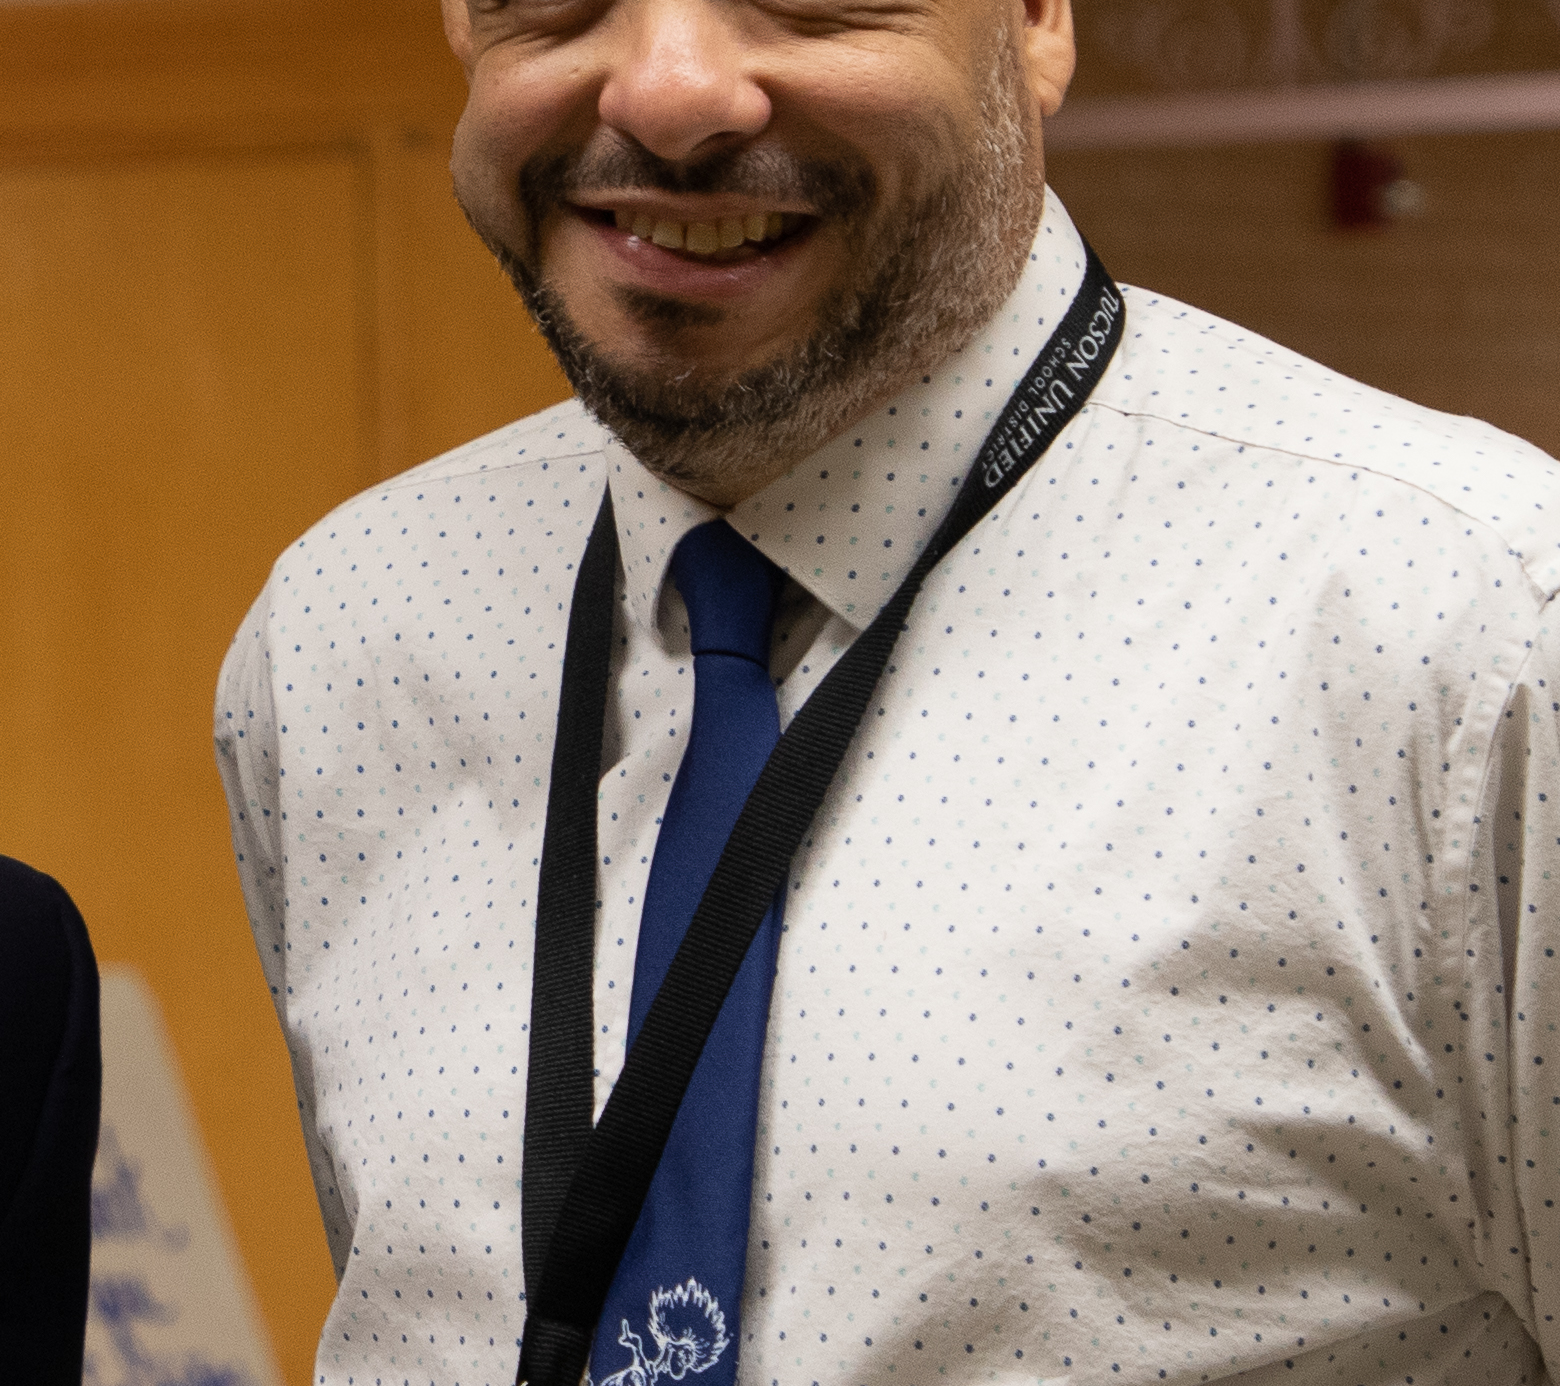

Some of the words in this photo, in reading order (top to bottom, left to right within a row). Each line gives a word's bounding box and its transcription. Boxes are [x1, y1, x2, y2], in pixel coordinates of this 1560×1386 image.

[1027, 337, 1072, 396] SCHOOL
[1065, 286, 1121, 381] TUCSON
[982, 399, 1030, 470] DISTRICT
[983, 379, 1075, 488] UNIFIED
